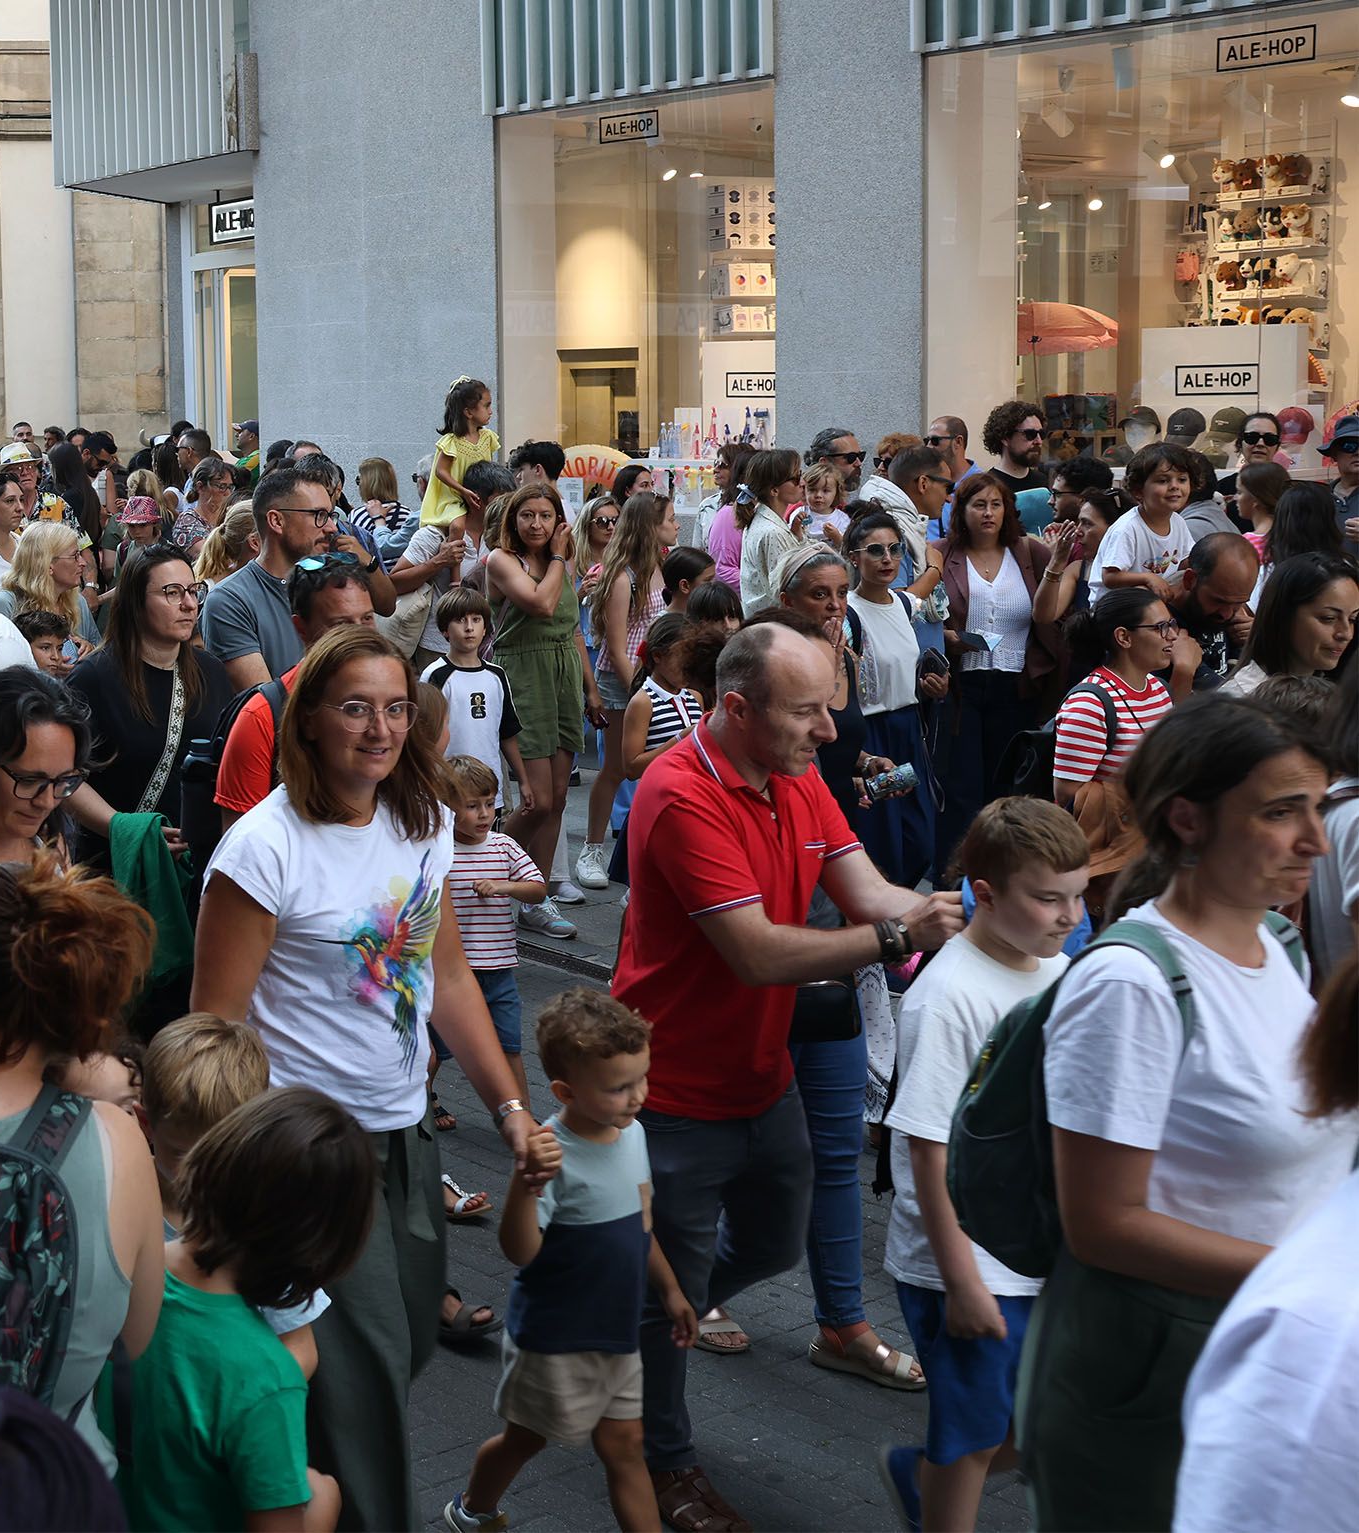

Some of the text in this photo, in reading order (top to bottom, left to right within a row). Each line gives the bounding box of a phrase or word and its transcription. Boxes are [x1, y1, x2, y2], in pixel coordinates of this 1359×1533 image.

[1225, 36, 1306, 62] ALE-HOP
[605, 118, 653, 136] ALE-HOP
[215, 208, 254, 233] ALE-HO
[731, 378, 776, 391] ALE-HO
[1183, 372, 1252, 388] ALE-HOP
[562, 456, 619, 480] VORIT
